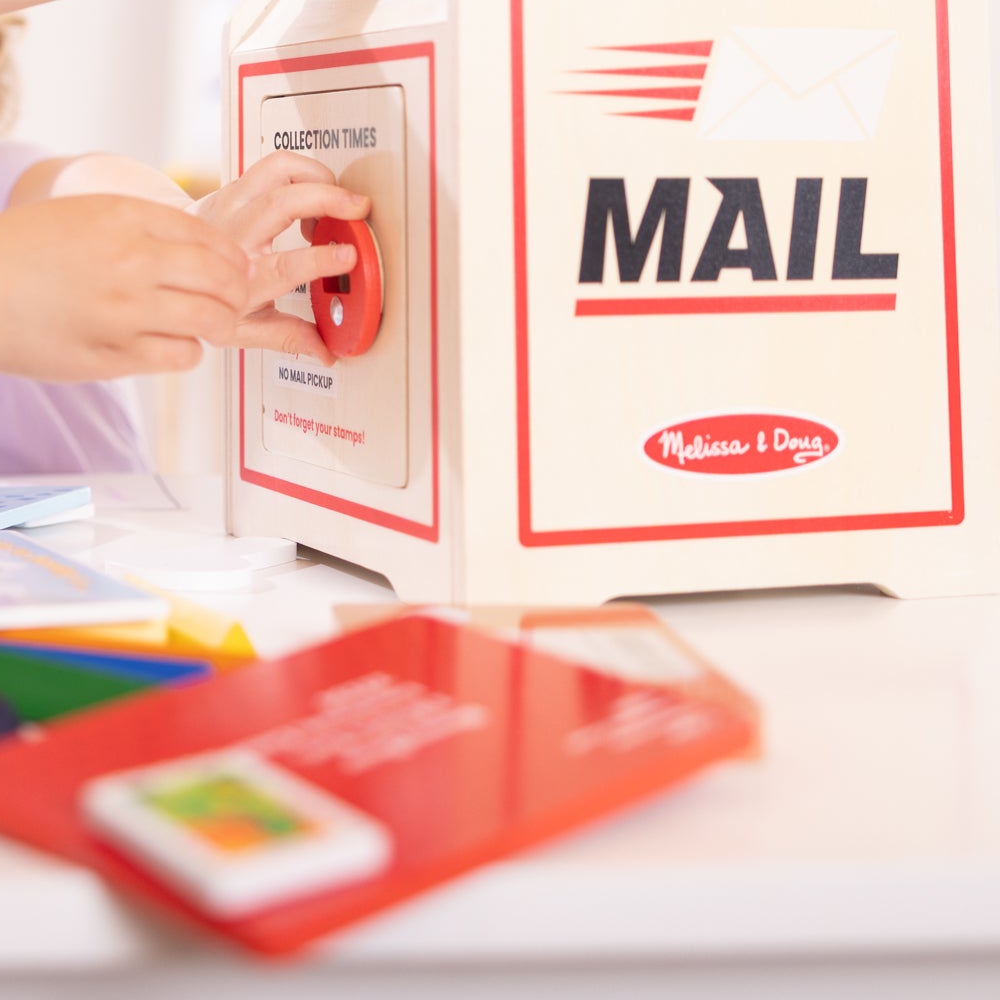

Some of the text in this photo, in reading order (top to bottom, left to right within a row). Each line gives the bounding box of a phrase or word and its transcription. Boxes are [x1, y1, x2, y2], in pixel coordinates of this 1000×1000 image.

[274, 127, 377, 150] COLLECTION TIMES
[577, 177, 900, 284] MAIL
[278, 366, 334, 390] NO MAIL PICKUP
[273, 409, 365, 447] Don't forget your stamps!
[657, 430, 750, 466] Melissa
